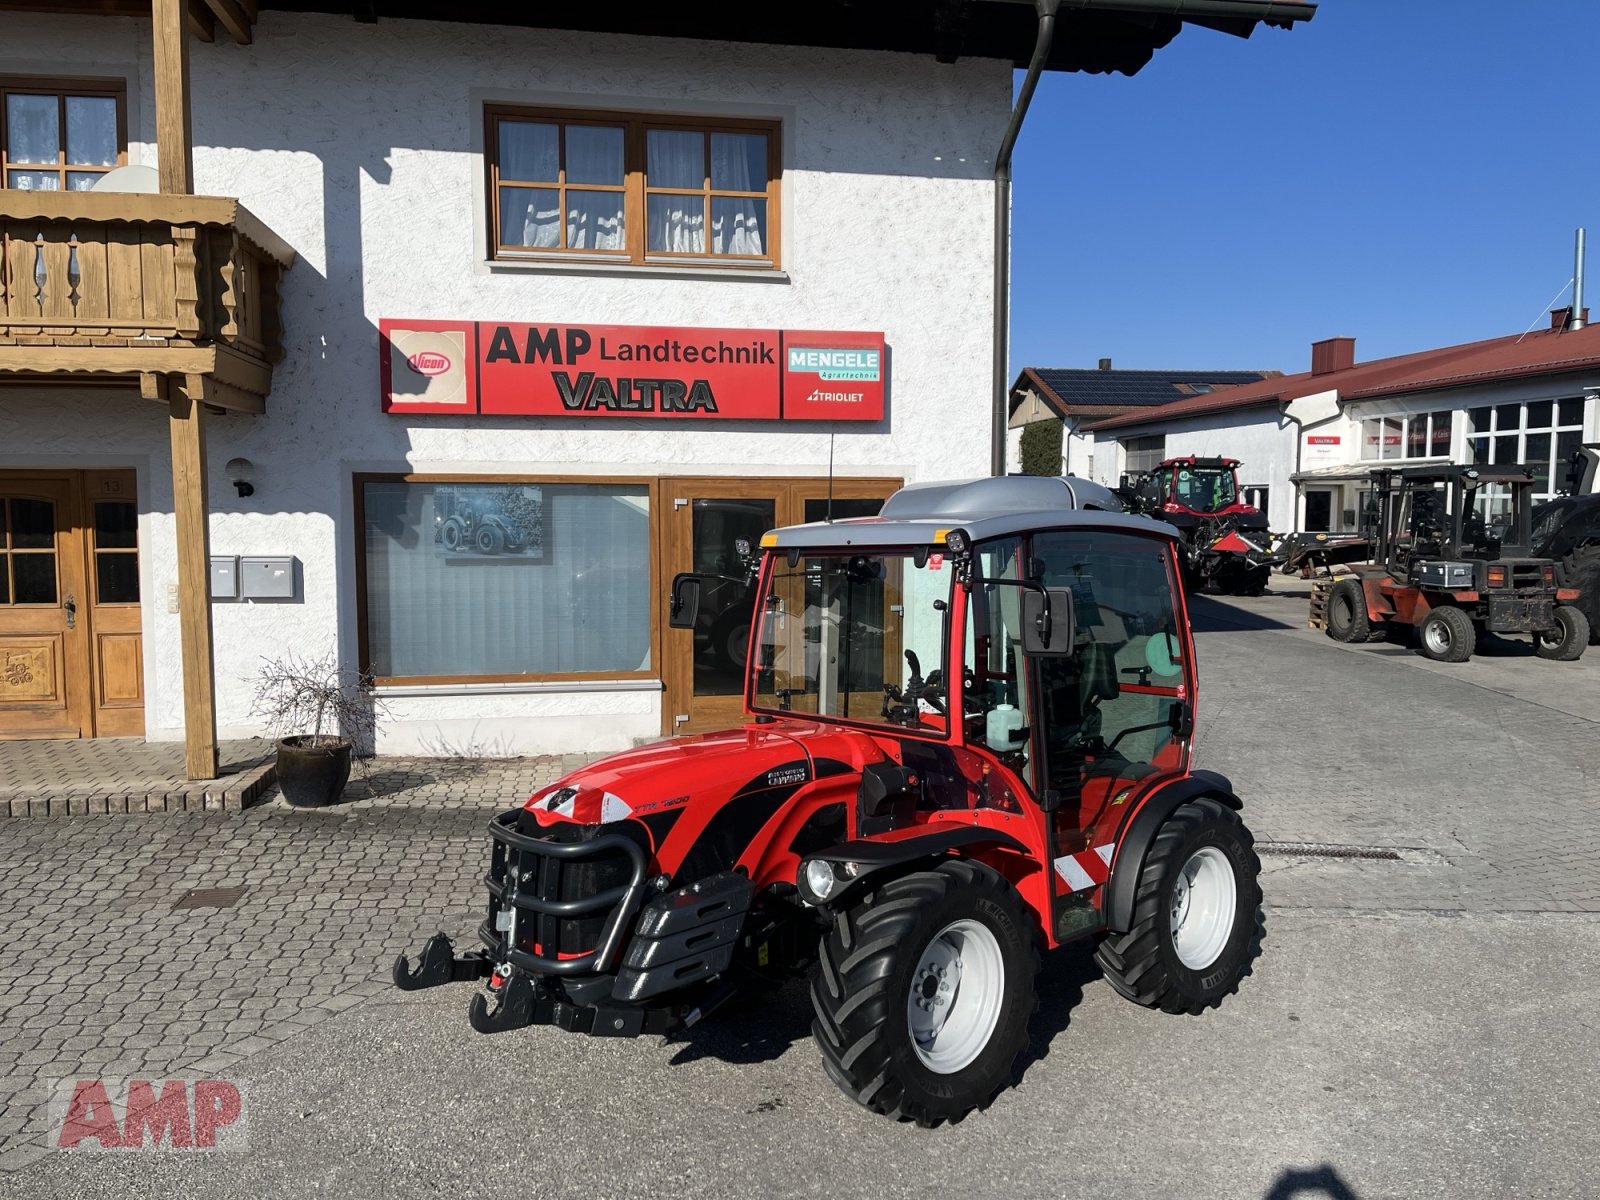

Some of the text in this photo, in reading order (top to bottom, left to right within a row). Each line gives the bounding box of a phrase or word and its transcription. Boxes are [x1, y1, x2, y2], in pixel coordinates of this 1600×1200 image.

[486, 326, 775, 365] AMP Landtechnik
[411, 352, 446, 370] Vicon
[791, 352, 878, 367] MENGELE
[821, 371, 877, 379] Agrartechnik
[550, 371, 719, 413] VALTRA
[818, 392, 864, 402] TRIOLIET
[103, 480, 120, 492] 13
